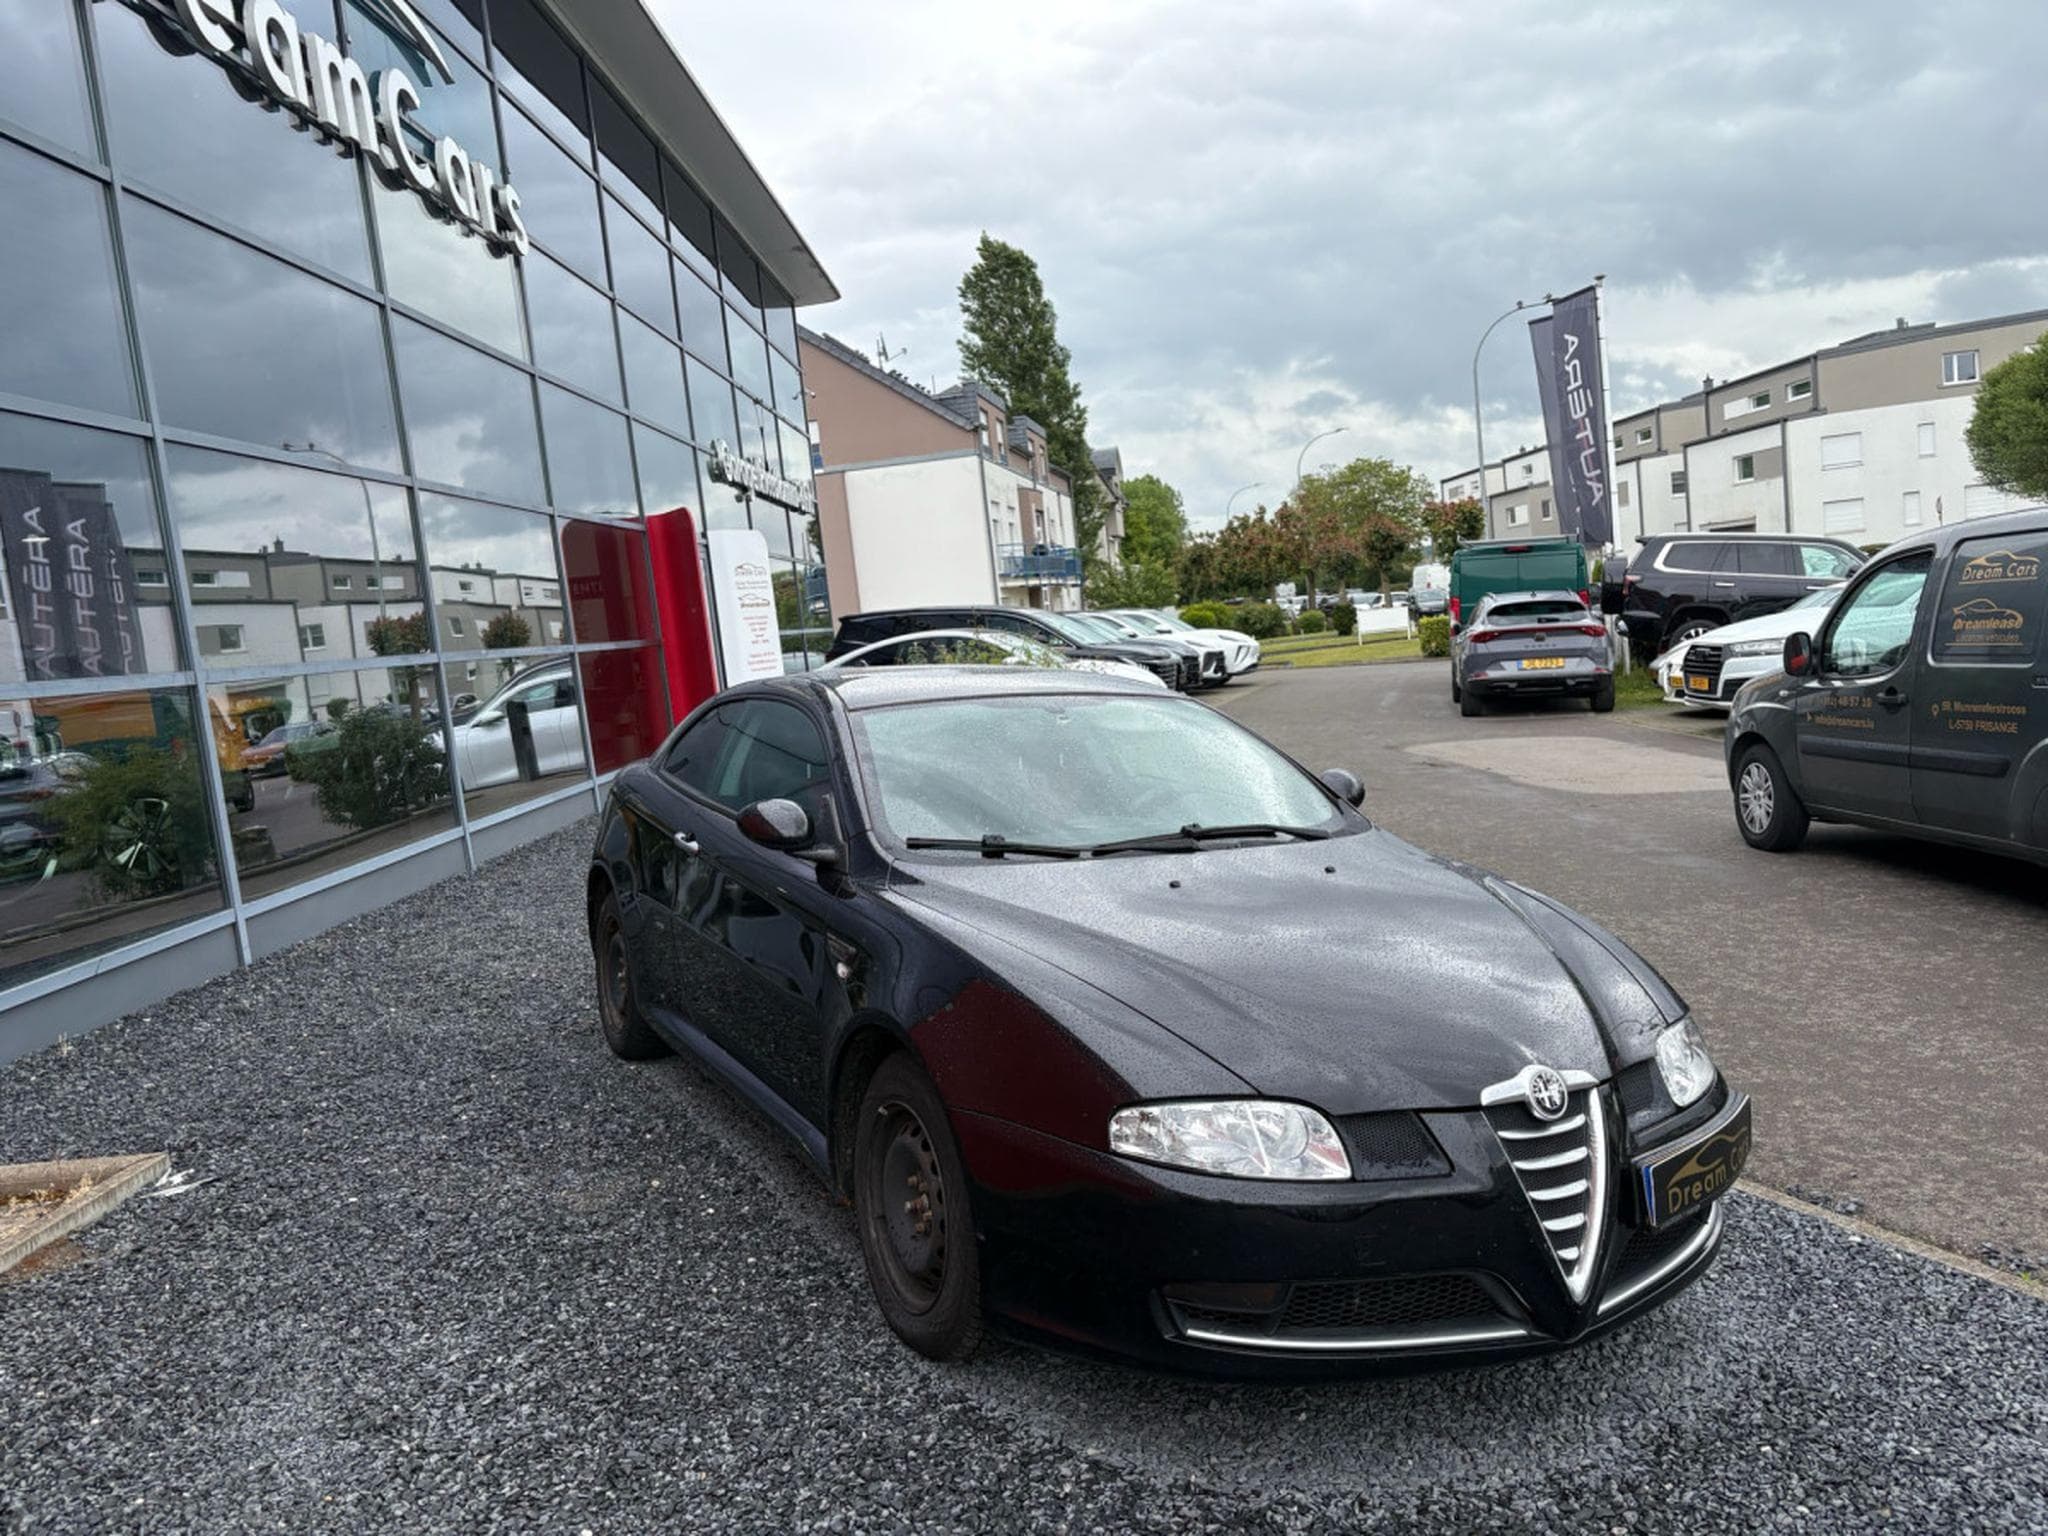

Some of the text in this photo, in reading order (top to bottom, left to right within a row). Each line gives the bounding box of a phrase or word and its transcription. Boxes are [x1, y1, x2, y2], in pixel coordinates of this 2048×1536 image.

[377, 67, 530, 256] Cars
[1962, 562, 2038, 580] Dream Cars
[1667, 1164, 1727, 1214] Dream
